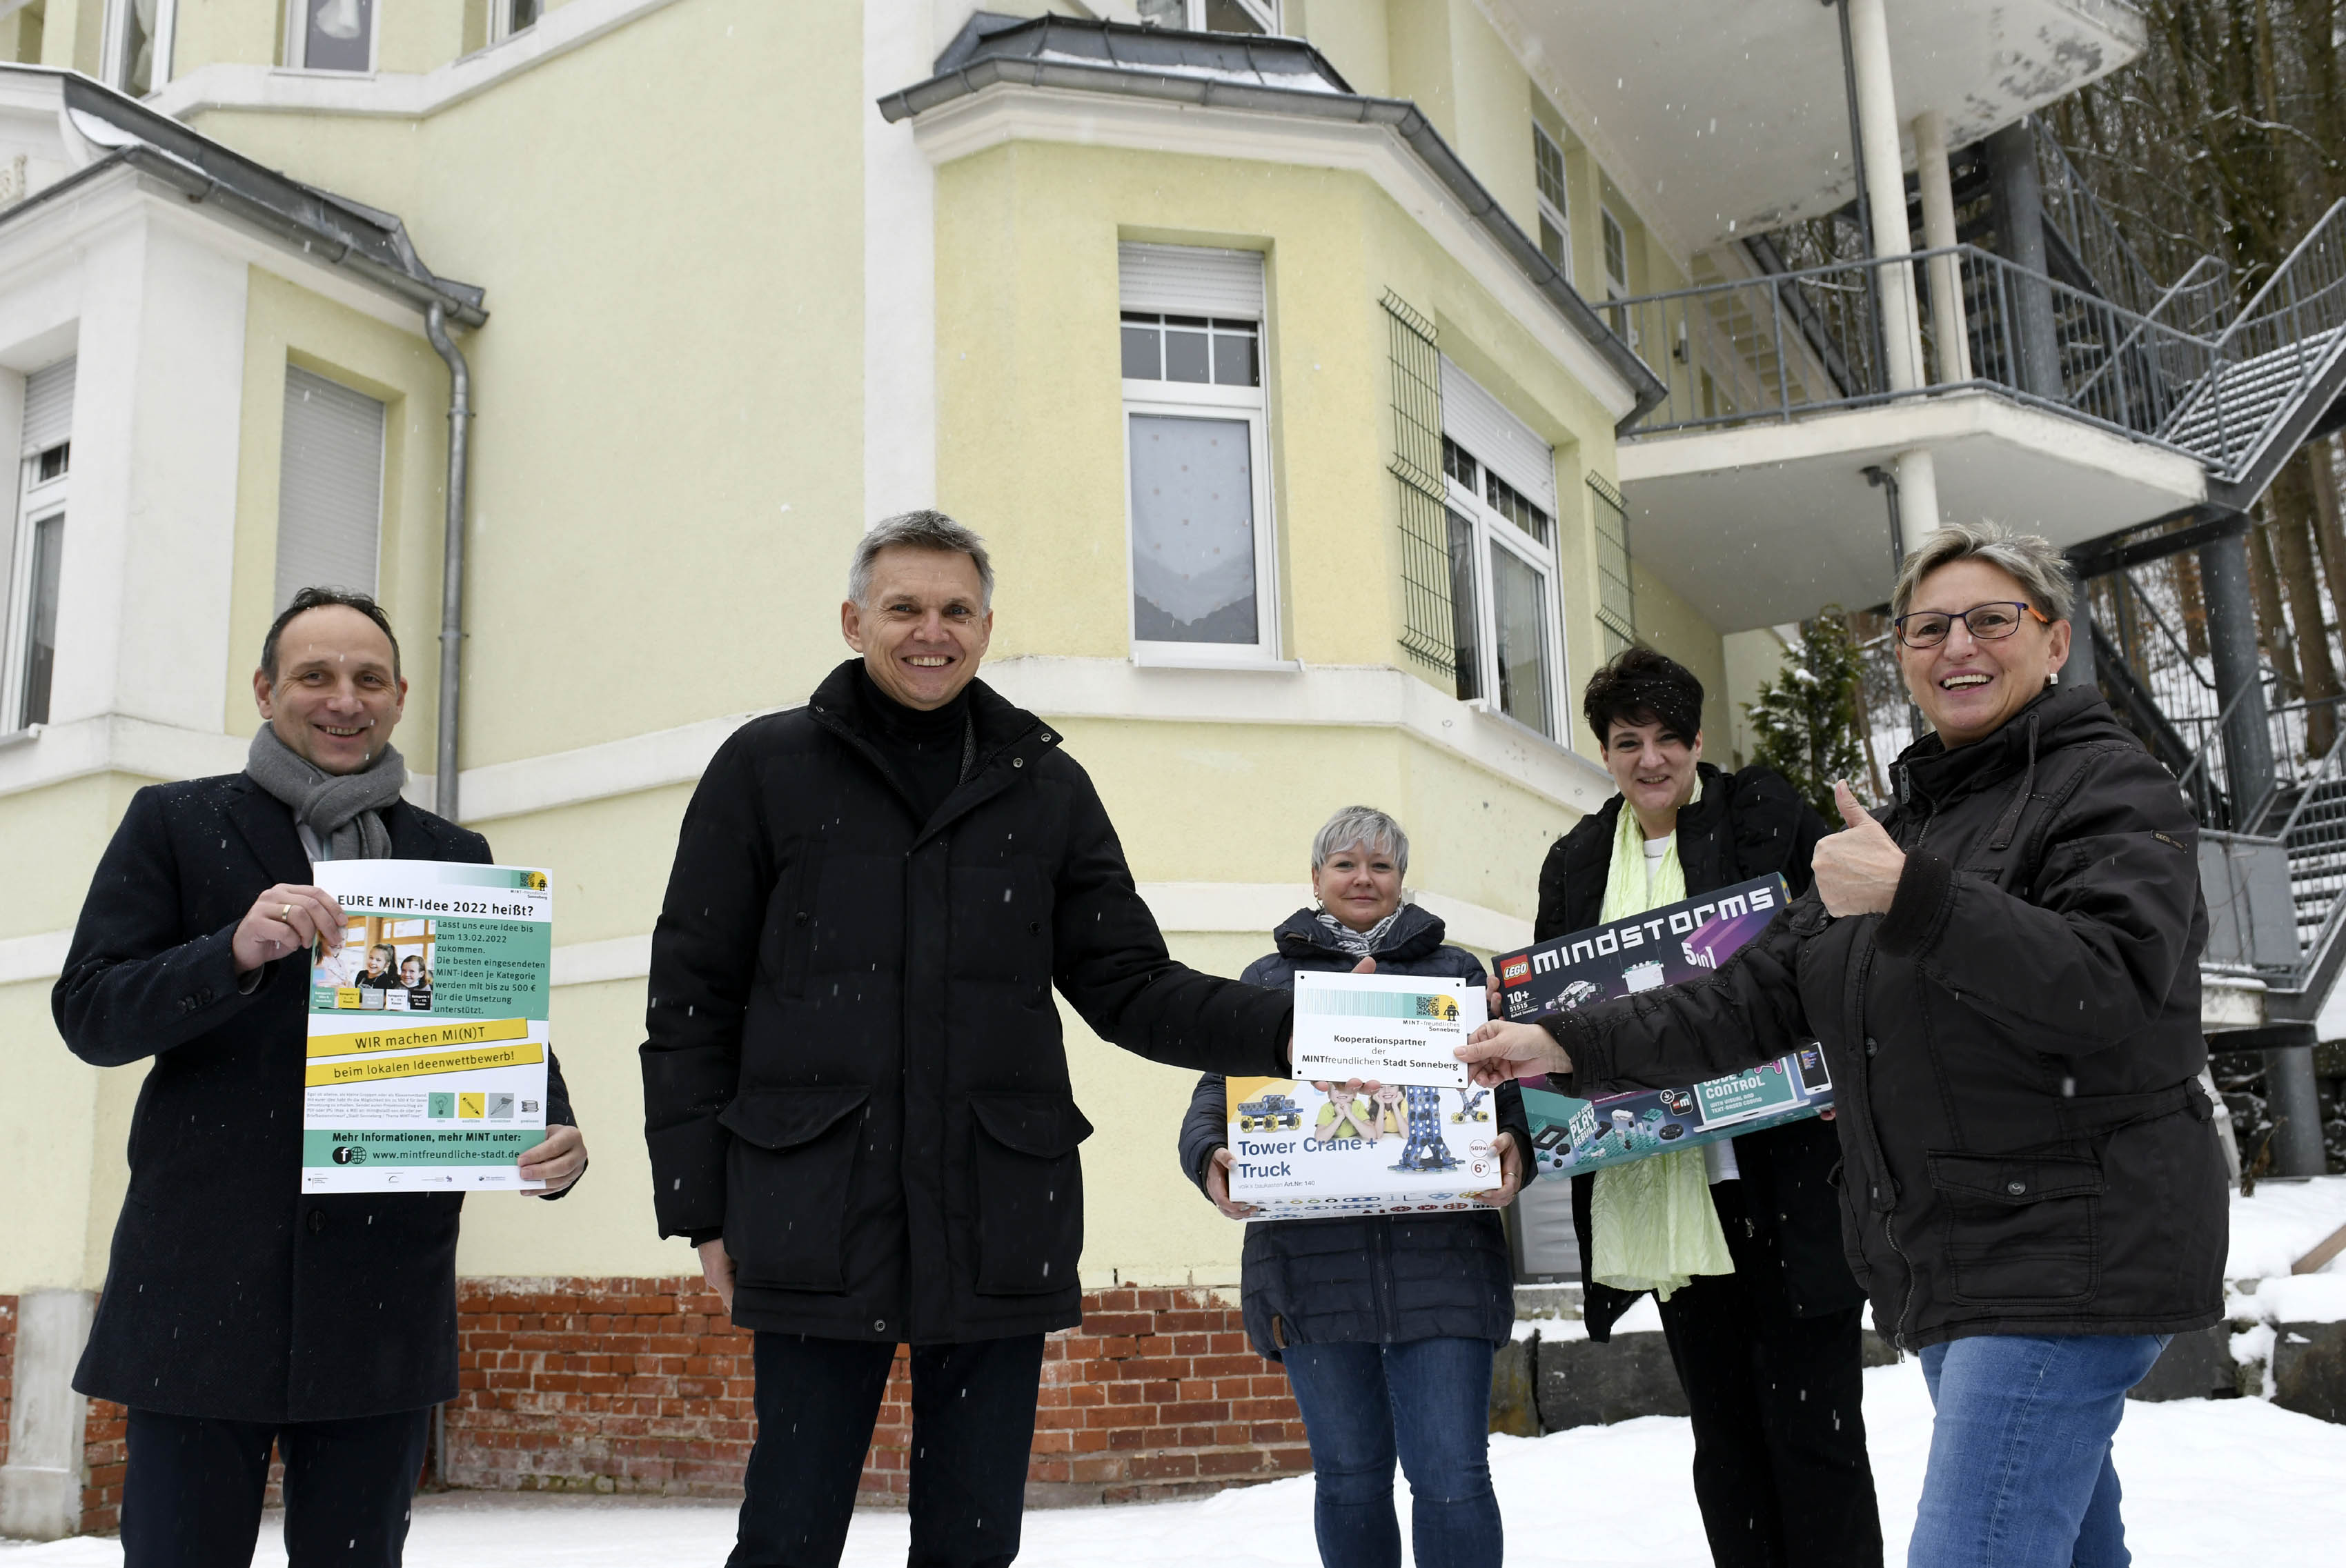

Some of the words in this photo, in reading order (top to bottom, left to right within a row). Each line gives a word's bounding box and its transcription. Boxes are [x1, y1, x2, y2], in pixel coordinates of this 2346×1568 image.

[337, 895, 374, 906] EURE
[379, 896, 448, 912] MINT-Idee
[453, 902, 487, 914] 2022
[492, 903, 534, 917] heißt?
[437, 921, 460, 930] Lasst
[500, 922, 519, 932] Idee
[521, 924, 534, 933] bis
[457, 933, 507, 943] 13.02.2022
[437, 944, 486, 954] zukommen.
[437, 956, 451, 965] Die
[453, 957, 482, 966] besten
[484, 957, 545, 969] eingesendeten
[436, 969, 484, 980] MINT-Ideen
[485, 971, 495, 980] je
[497, 971, 535, 981] Kategorie
[1504, 963, 1527, 978] LEGO
[435, 981, 467, 990] werden
[469, 982, 483, 990] mit
[484, 982, 497, 991] bis
[512, 983, 529, 992] 500
[530, 984, 536, 992] €
[435, 993, 446, 1002] für
[448, 993, 462, 1002] die
[465, 994, 512, 1004] Umsetzung
[1507, 991, 1530, 1004] 10+
[435, 1004, 484, 1015] unterstützt.
[1509, 1002, 1528, 1012] 51515
[355, 1037, 381, 1049] WIR
[386, 1033, 438, 1046] machen
[442, 1026, 485, 1042] MI(N)T
[1334, 1035, 1426, 1046] Kooperationspartner
[334, 1066, 363, 1078] beim
[366, 1062, 409, 1075] lokalen
[413, 1051, 515, 1070] Ideenwettbewerb!
[1301, 1055, 1380, 1066] MINTfreundlichen
[1383, 1058, 1408, 1067] Stadt
[1410, 1060, 1459, 1071] Sonneberg
[1706, 1075, 1766, 1099] CONTROL
[1570, 1107, 1595, 1140] PLAY
[332, 1132, 358, 1142] Mehr
[362, 1132, 435, 1144] Informationen,
[438, 1133, 463, 1142] mehr
[466, 1133, 490, 1142] MINT
[493, 1133, 521, 1142] unter:
[1573, 1121, 1597, 1148] REBUILD
[1237, 1141, 1297, 1156] Tower
[1303, 1137, 1362, 1153] Crane
[373, 1149, 520, 1160] www.mintfreundliche-stadt.de
[1238, 1161, 1291, 1178] Truck
